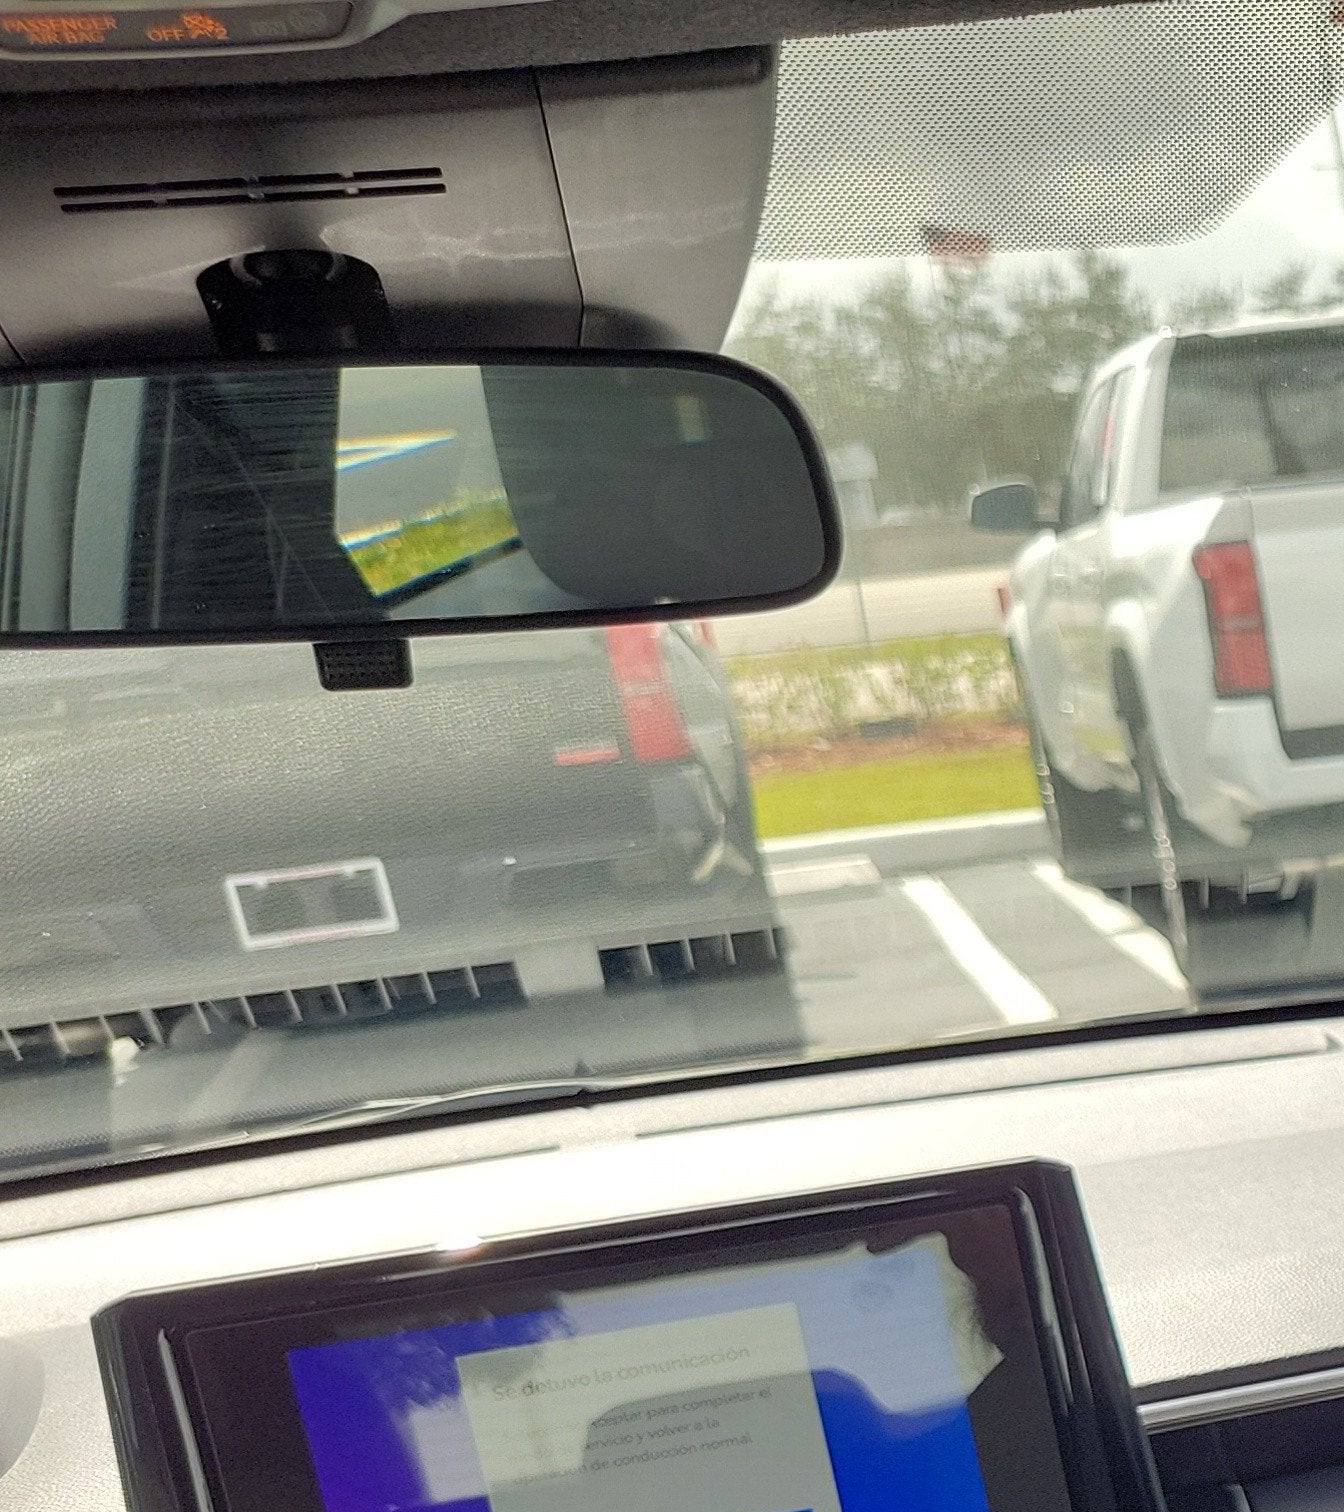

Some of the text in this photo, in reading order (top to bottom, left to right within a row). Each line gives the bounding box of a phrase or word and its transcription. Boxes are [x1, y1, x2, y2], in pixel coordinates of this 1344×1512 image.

[2, 15, 118, 32] PASSENGER
[28, 31, 60, 45] AIR
[146, 27, 185, 42] OFF
[592, 1367, 612, 1384] la
[649, 1423, 692, 1438] volver
[591, 1458, 609, 1472] de
[700, 1433, 753, 1451] normal
